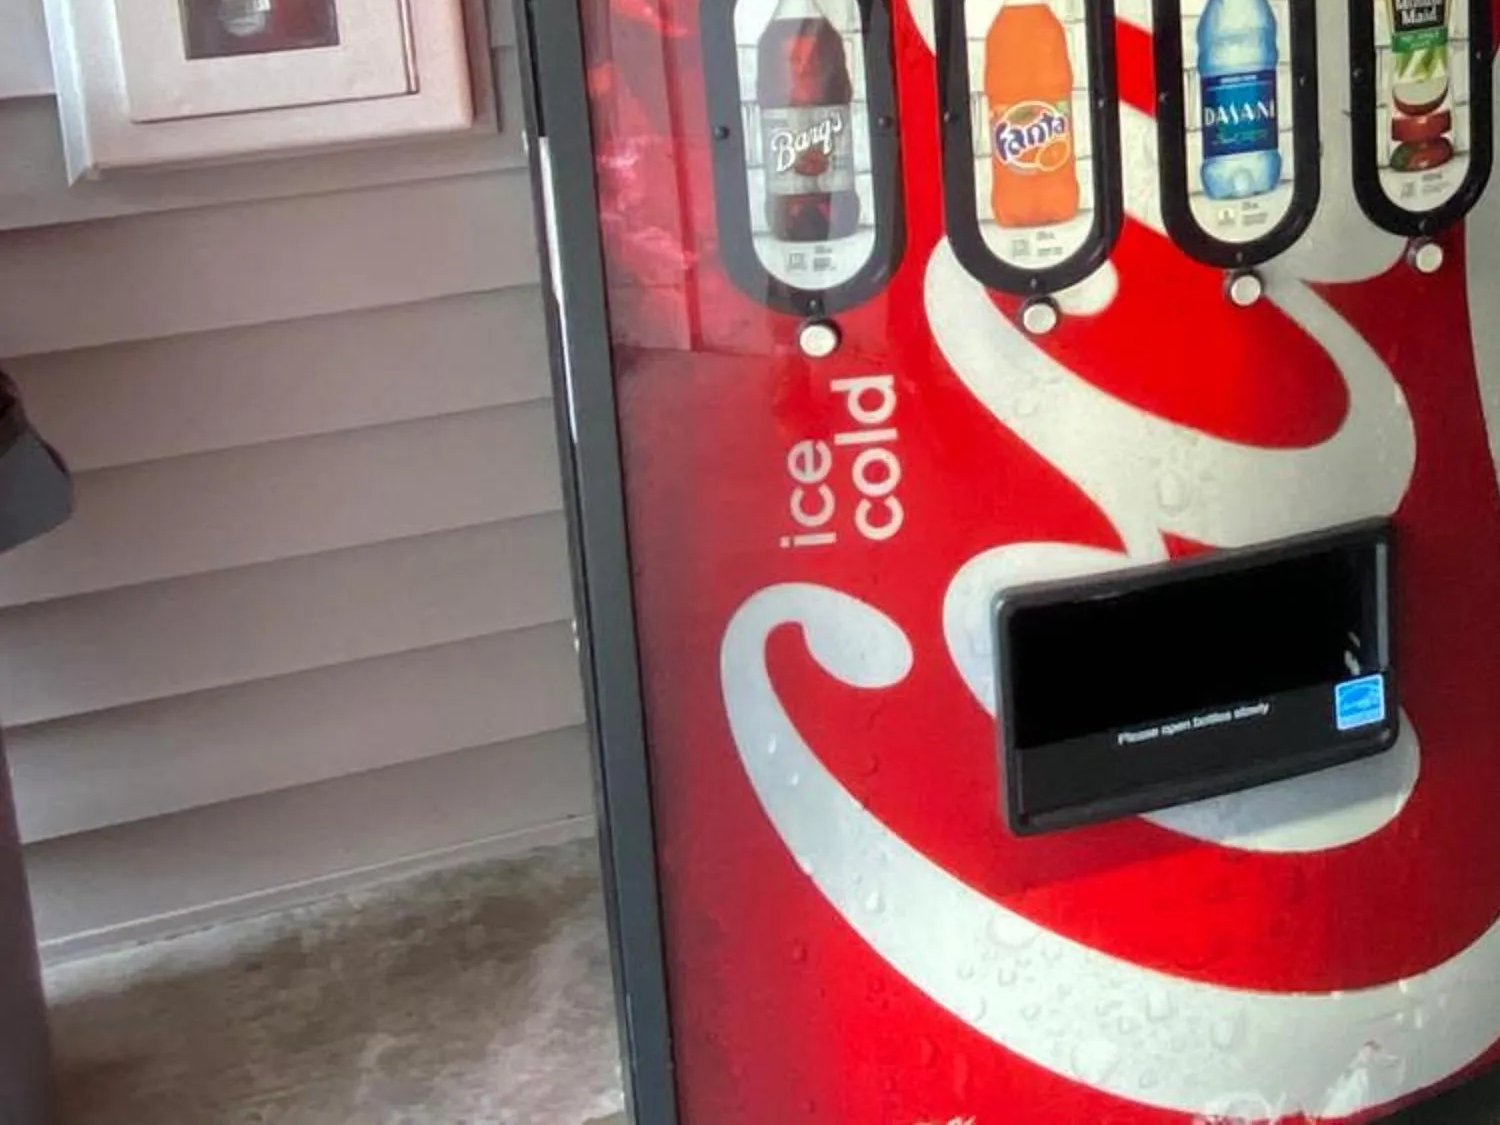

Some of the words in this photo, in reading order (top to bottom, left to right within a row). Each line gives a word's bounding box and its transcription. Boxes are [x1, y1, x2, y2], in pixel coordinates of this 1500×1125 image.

[994, 112, 1068, 164] Fanta
[1204, 98, 1275, 127] DASANI
[770, 114, 843, 173] Barq's
[830, 375, 904, 541] cold
[780, 439, 837, 548] ice
